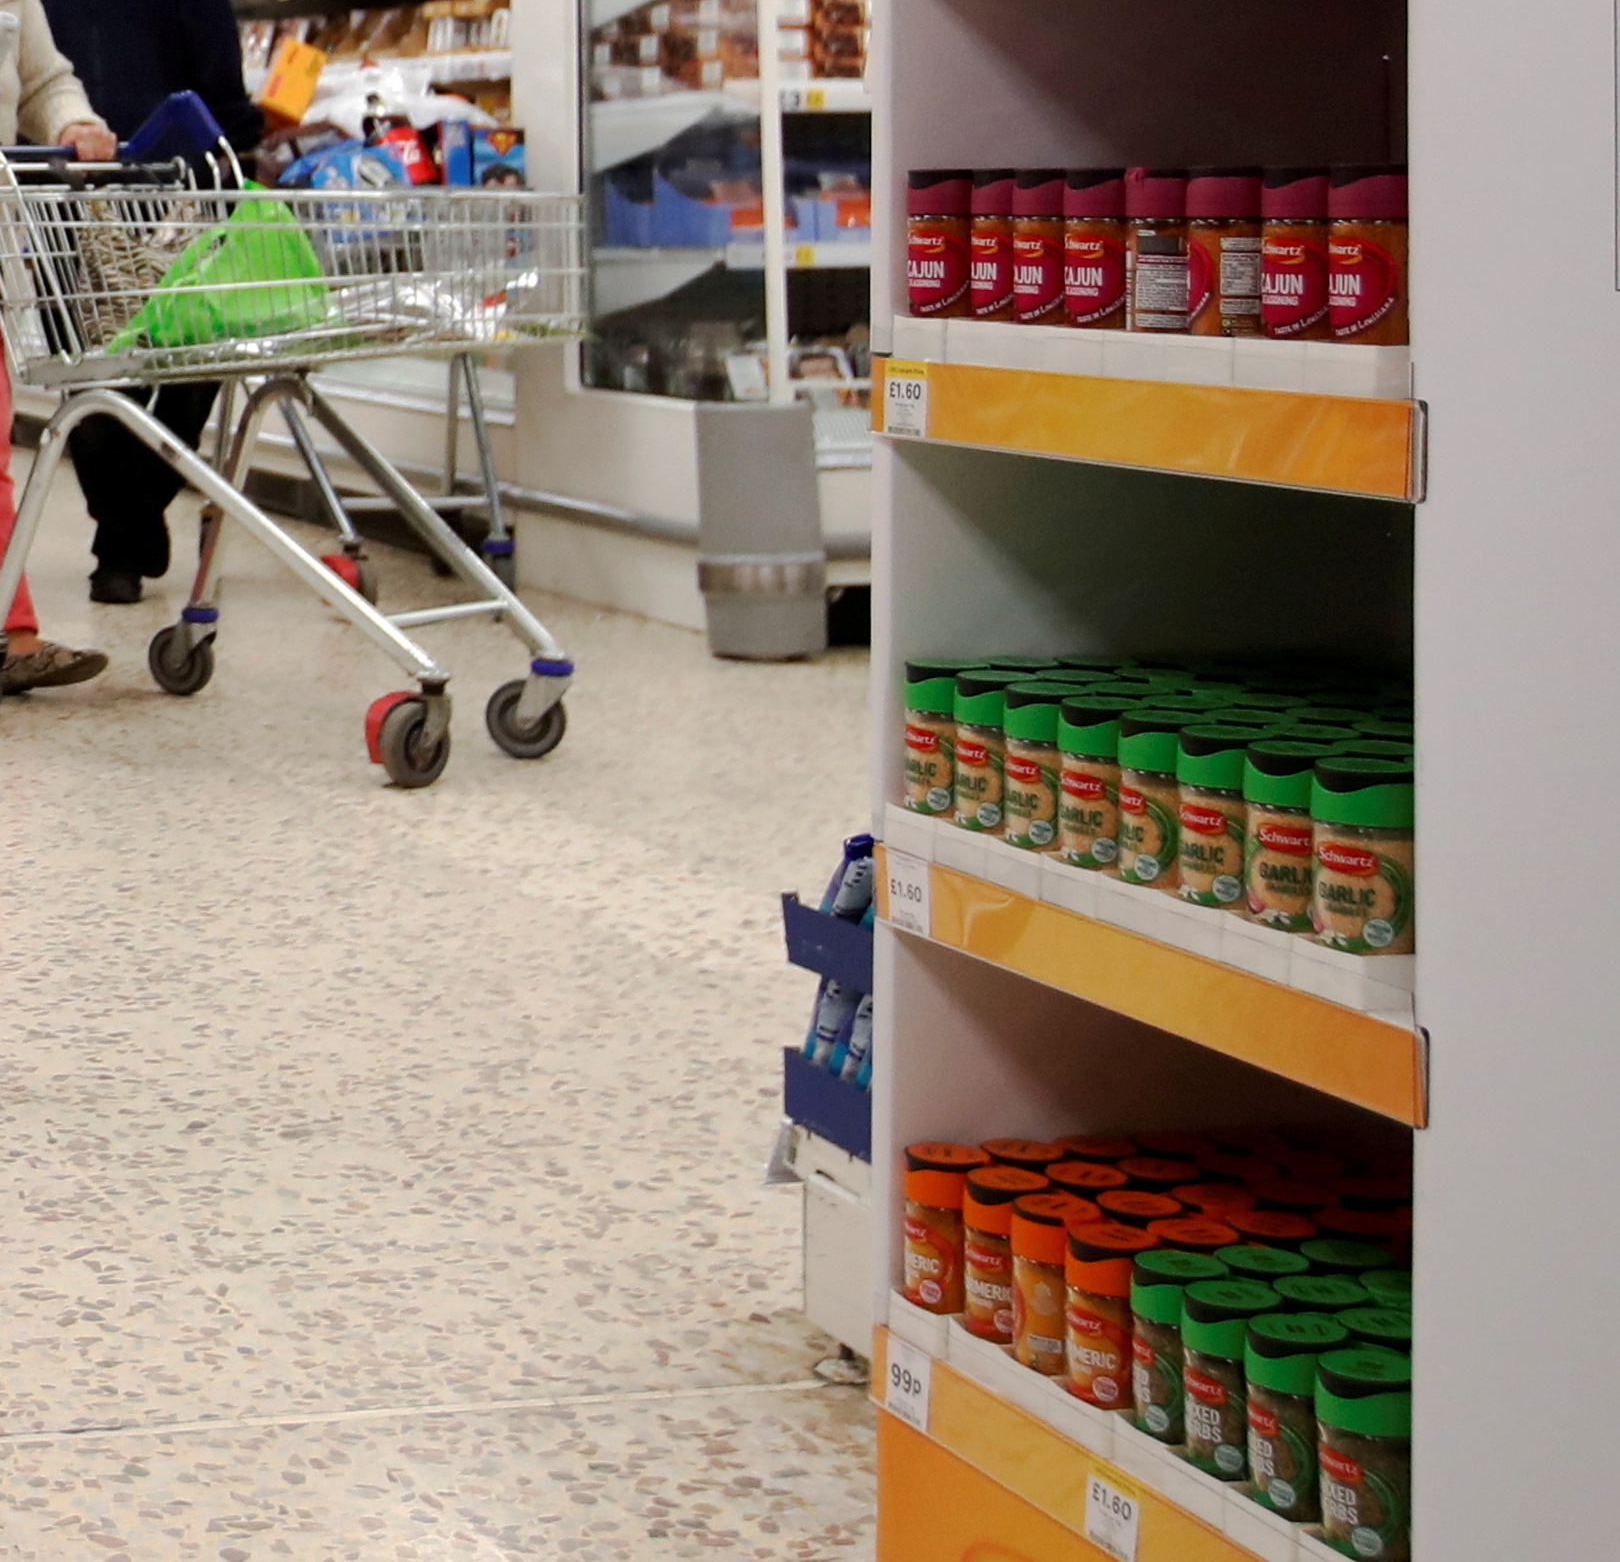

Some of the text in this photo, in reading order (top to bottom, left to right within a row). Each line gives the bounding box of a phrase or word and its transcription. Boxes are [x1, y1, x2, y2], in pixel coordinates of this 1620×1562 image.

[889, 381, 921, 400] £1.60
[1319, 848, 1374, 868] Schwartz
[890, 878, 921, 903] £1.60
[1319, 880, 1376, 907] GARLIC
[891, 1362, 922, 1397] 99p
[1092, 1482, 1132, 1520] £1.60
